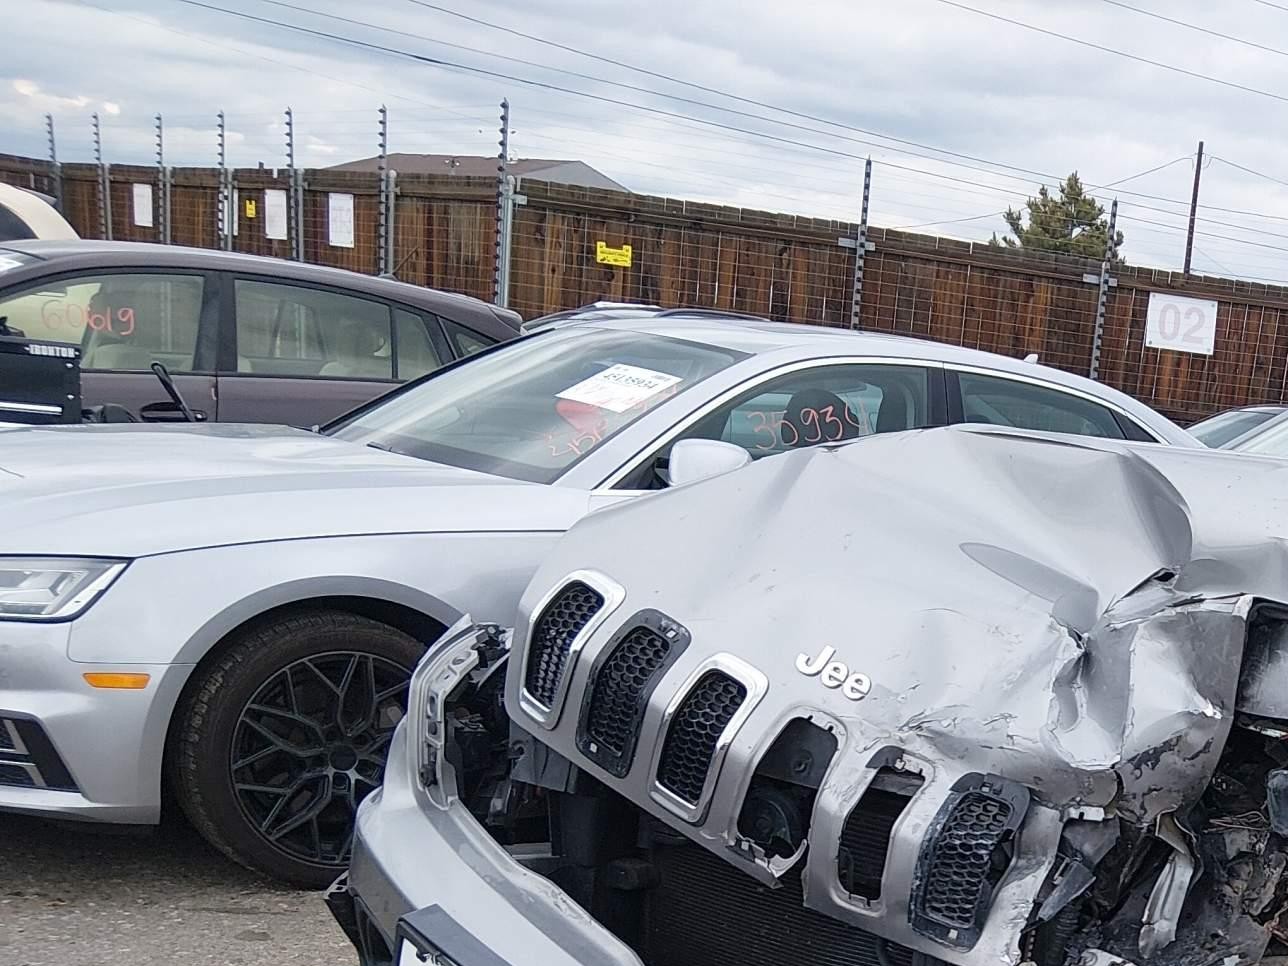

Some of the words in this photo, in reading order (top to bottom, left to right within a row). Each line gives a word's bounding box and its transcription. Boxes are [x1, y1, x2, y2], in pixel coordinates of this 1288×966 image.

[42, 299, 135, 336] 60619
[1158, 302, 1206, 345] 02
[795, 645, 872, 701] Jee
